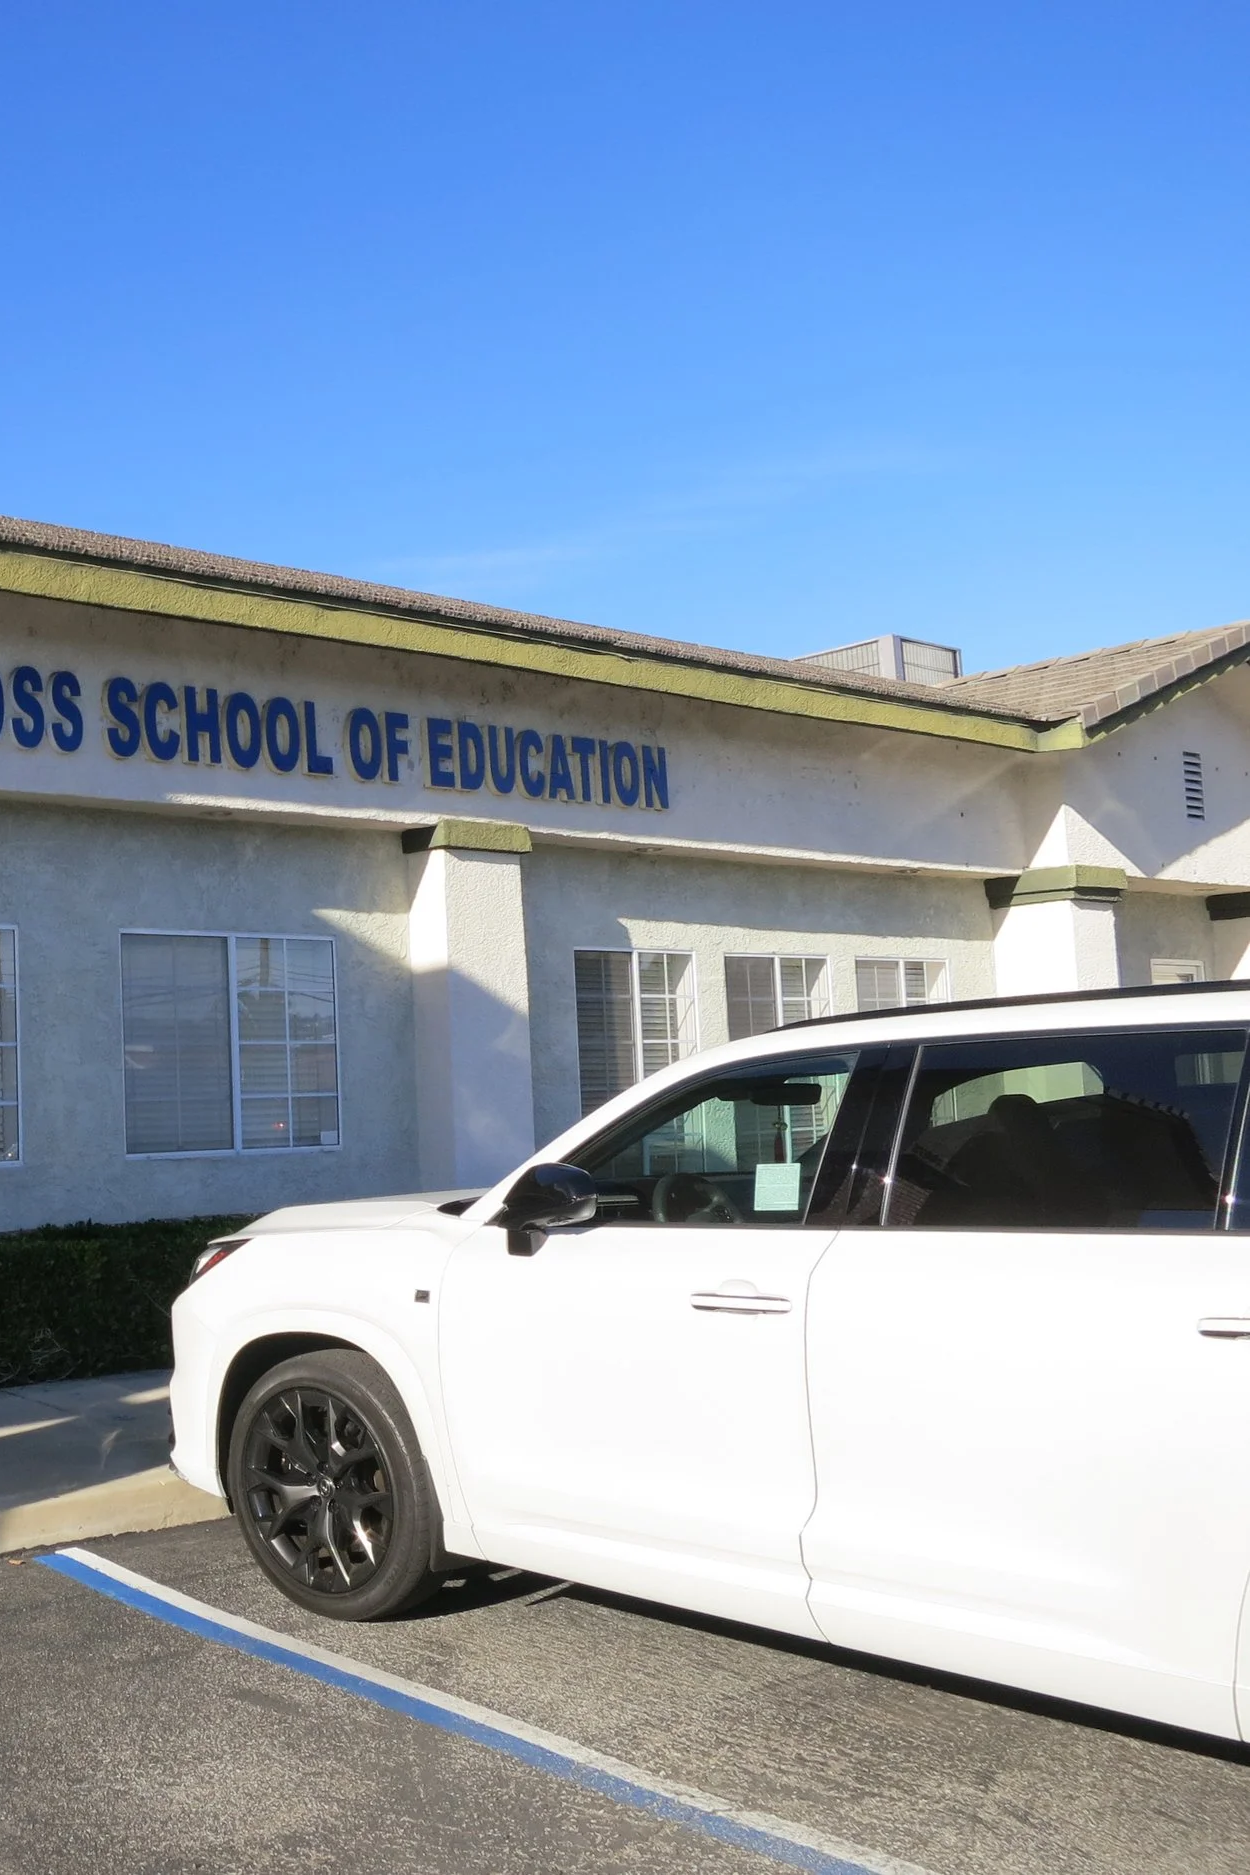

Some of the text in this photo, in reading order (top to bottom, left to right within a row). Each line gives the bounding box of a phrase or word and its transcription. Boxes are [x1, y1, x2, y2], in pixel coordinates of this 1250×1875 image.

[102, 676, 333, 776] SCHOOL
[348, 707, 409, 783] OF
[424, 717, 670, 811] EDUCATION
